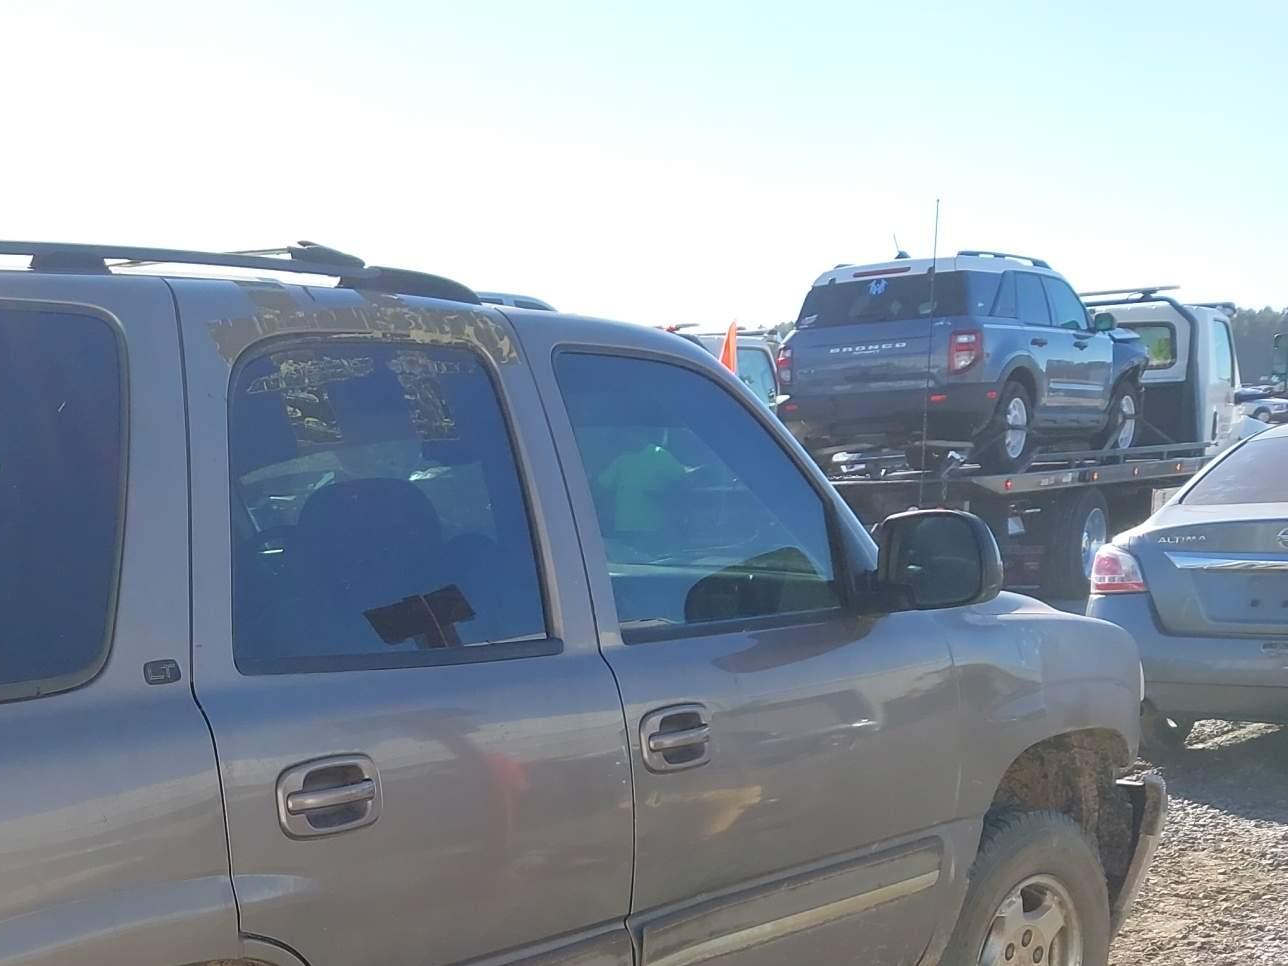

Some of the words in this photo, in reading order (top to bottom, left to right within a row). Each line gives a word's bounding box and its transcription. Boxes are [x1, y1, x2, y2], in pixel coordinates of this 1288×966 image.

[829, 342, 907, 353] BRONCO
[1157, 534, 1207, 545] ALTIMA
[147, 661, 177, 681] LT
